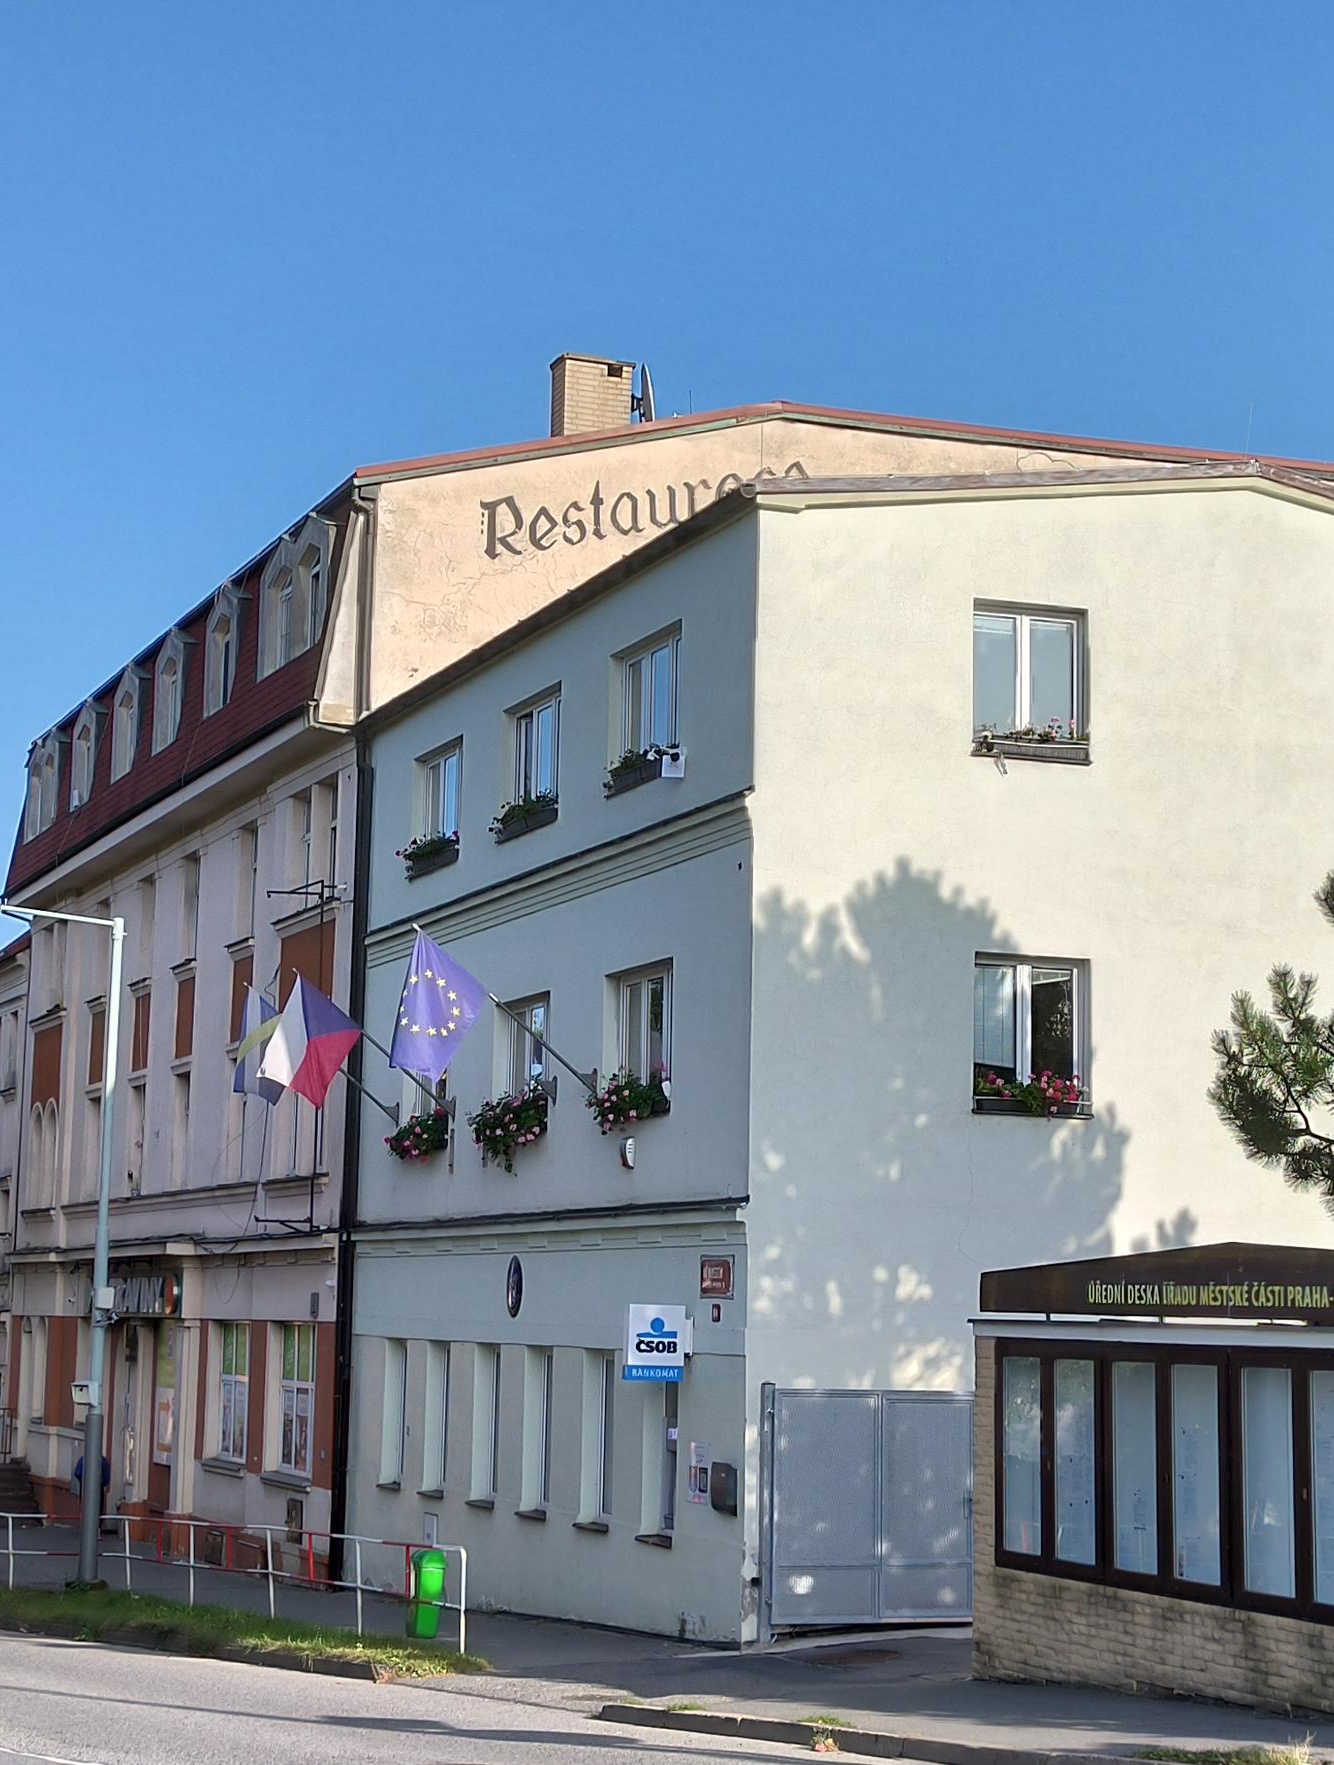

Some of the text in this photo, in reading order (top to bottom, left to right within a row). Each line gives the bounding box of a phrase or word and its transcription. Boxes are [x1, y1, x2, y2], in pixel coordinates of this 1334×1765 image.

[1088, 1279, 1125, 1304] ÚŘEDNÍ
[1128, 1284, 1160, 1305] DESKA
[1199, 1281, 1248, 1307] MĚSTSKÉ
[1251, 1281, 1284, 1307] ČÁSTI
[636, 1338, 677, 1354] ČSOB
[631, 1367, 679, 1378] BANKOMAT
